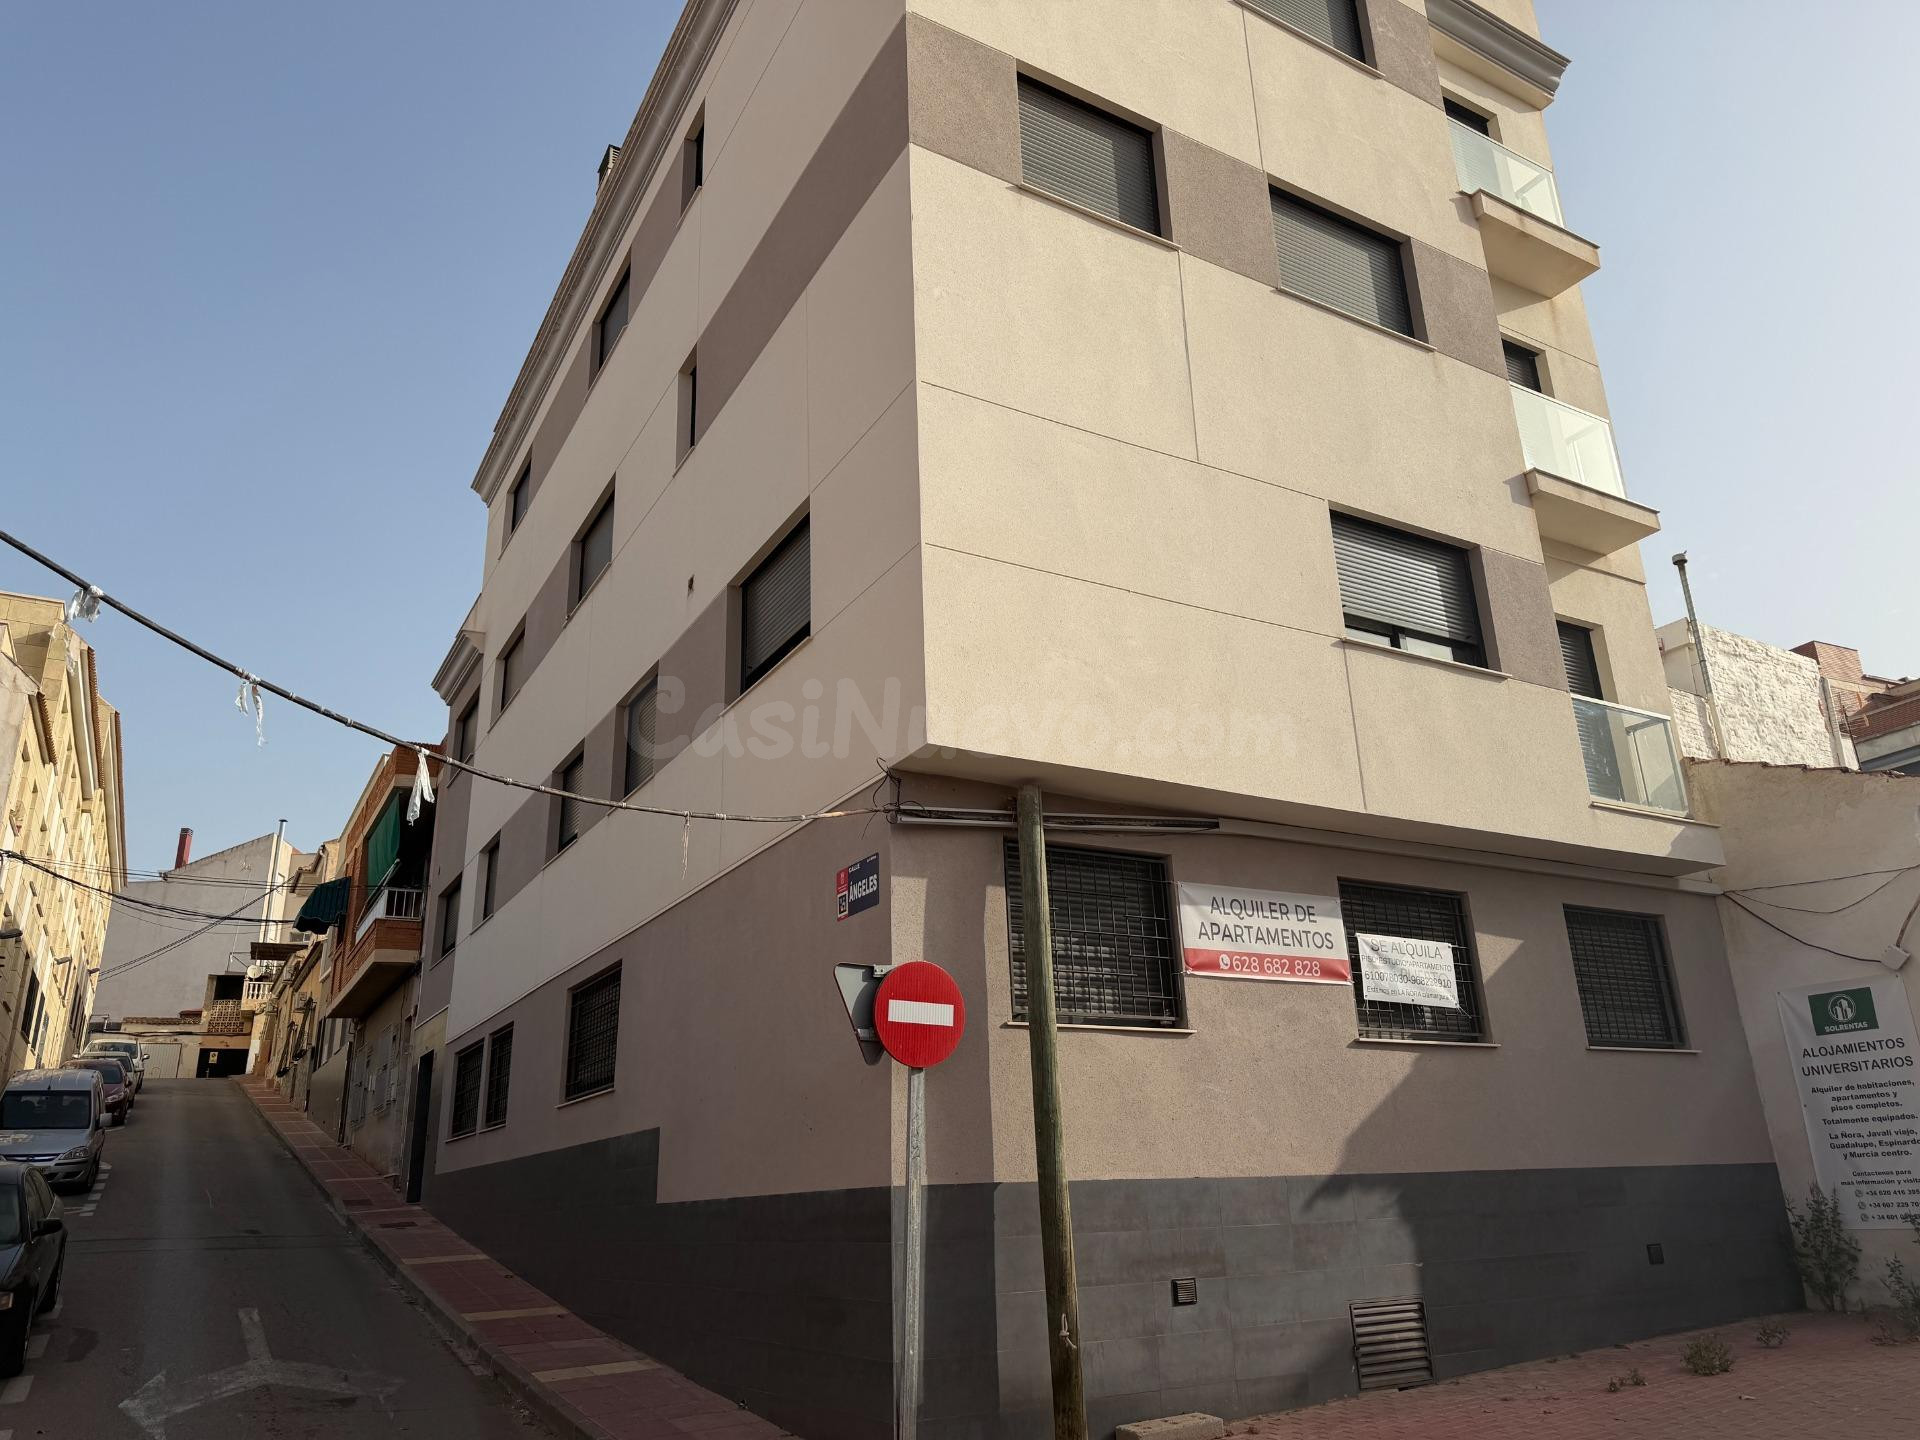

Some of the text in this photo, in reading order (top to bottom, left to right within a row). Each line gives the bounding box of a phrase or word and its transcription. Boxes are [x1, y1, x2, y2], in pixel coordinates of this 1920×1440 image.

[849, 874, 877, 902] ÁNGELES
[1210, 896, 1317, 923] ALQUILER DE
[1198, 922, 1334, 949] APARTAMENTOS
[1371, 938, 1442, 959] SE ALQUILA
[1233, 955, 1320, 977] 628 682 828
[1802, 1037, 1905, 1058] ALOJAMIENTOS
[1802, 1056, 1913, 1077] UNIVERSITARIOS
[1811, 1079, 1915, 1094] Alquiler de habitaciones,
[1831, 1092, 1891, 1103] apartamentos
[1831, 1101, 1903, 1113] pisos completos.
[1822, 1113, 1918, 1126] Totalmente equipados.
[1829, 1132, 1839, 1140] La
[1830, 1140, 1877, 1150] Guadalupe,
[1849, 1150, 1879, 1159] Murcia
[1881, 1149, 1912, 1157] centro.
